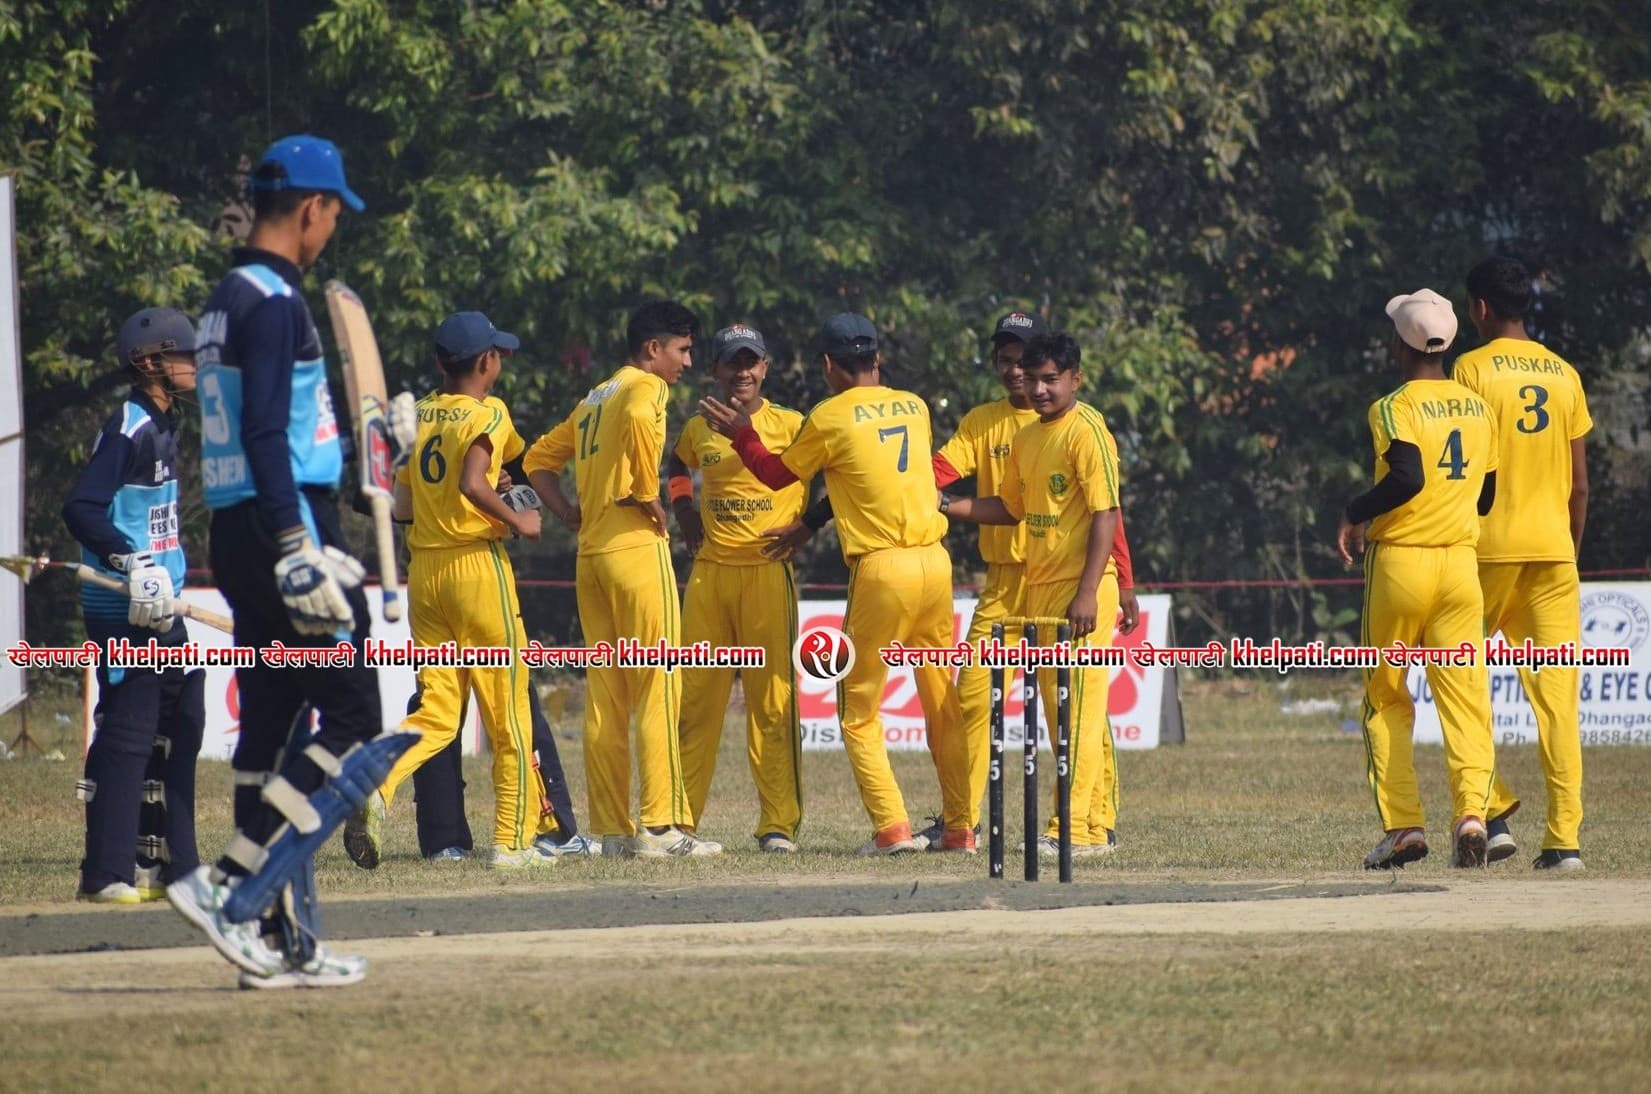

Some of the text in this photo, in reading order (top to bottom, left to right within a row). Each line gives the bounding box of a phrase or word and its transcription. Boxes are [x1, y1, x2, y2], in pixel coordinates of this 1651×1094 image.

[1492, 355, 1565, 376] PUSKAR
[854, 400, 921, 422] AYAR
[1516, 385, 1549, 433] 3
[420, 434, 446, 484] 6
[878, 425, 908, 473] 7
[1437, 428, 1470, 480] 4
[747, 498, 773, 511] SCHOOL
[1580, 672, 1592, 701] &
[1600, 672, 1638, 701] EYE
